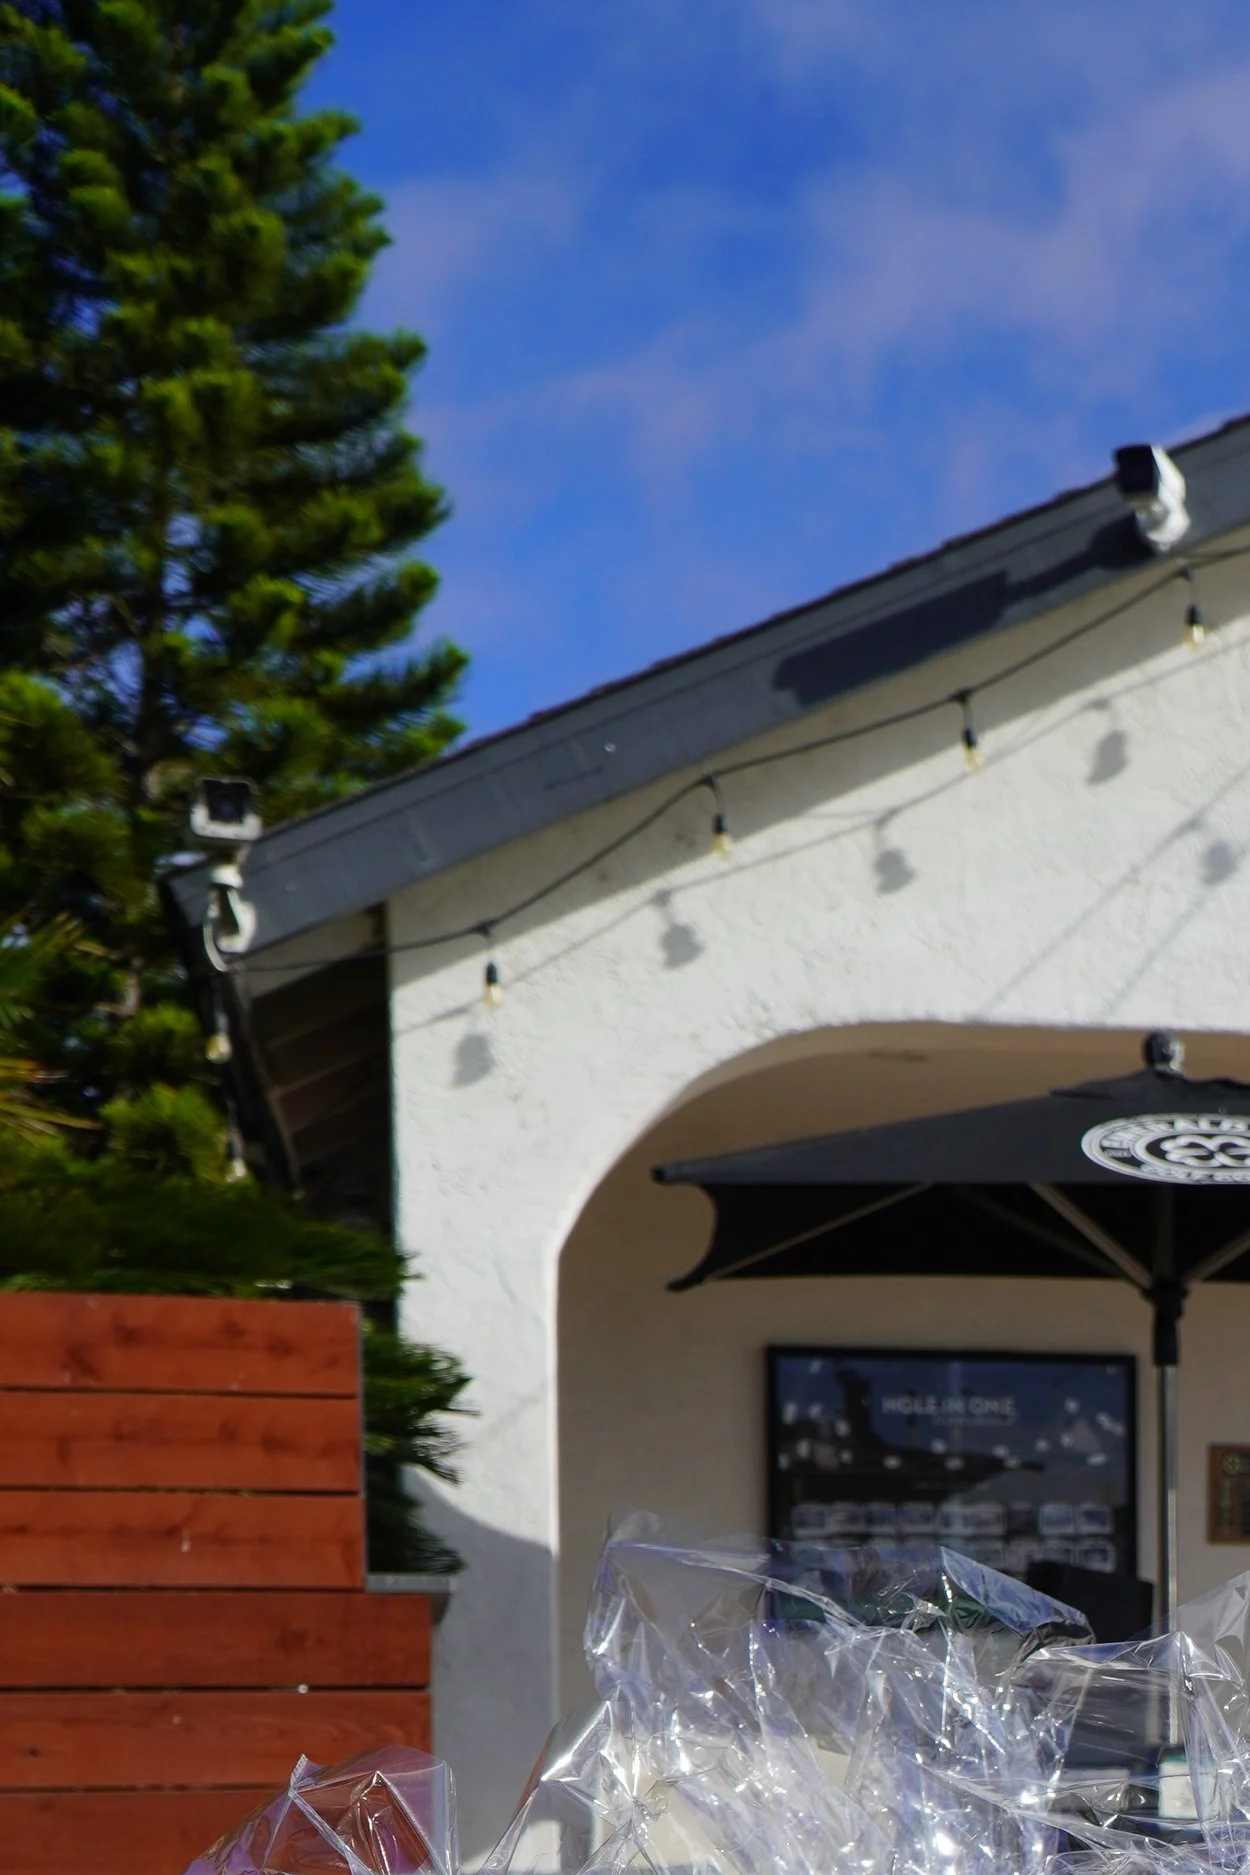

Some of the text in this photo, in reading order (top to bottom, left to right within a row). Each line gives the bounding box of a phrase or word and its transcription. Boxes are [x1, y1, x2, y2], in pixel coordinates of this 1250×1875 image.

[881, 1396, 1016, 1415] HOLE IN ONE
